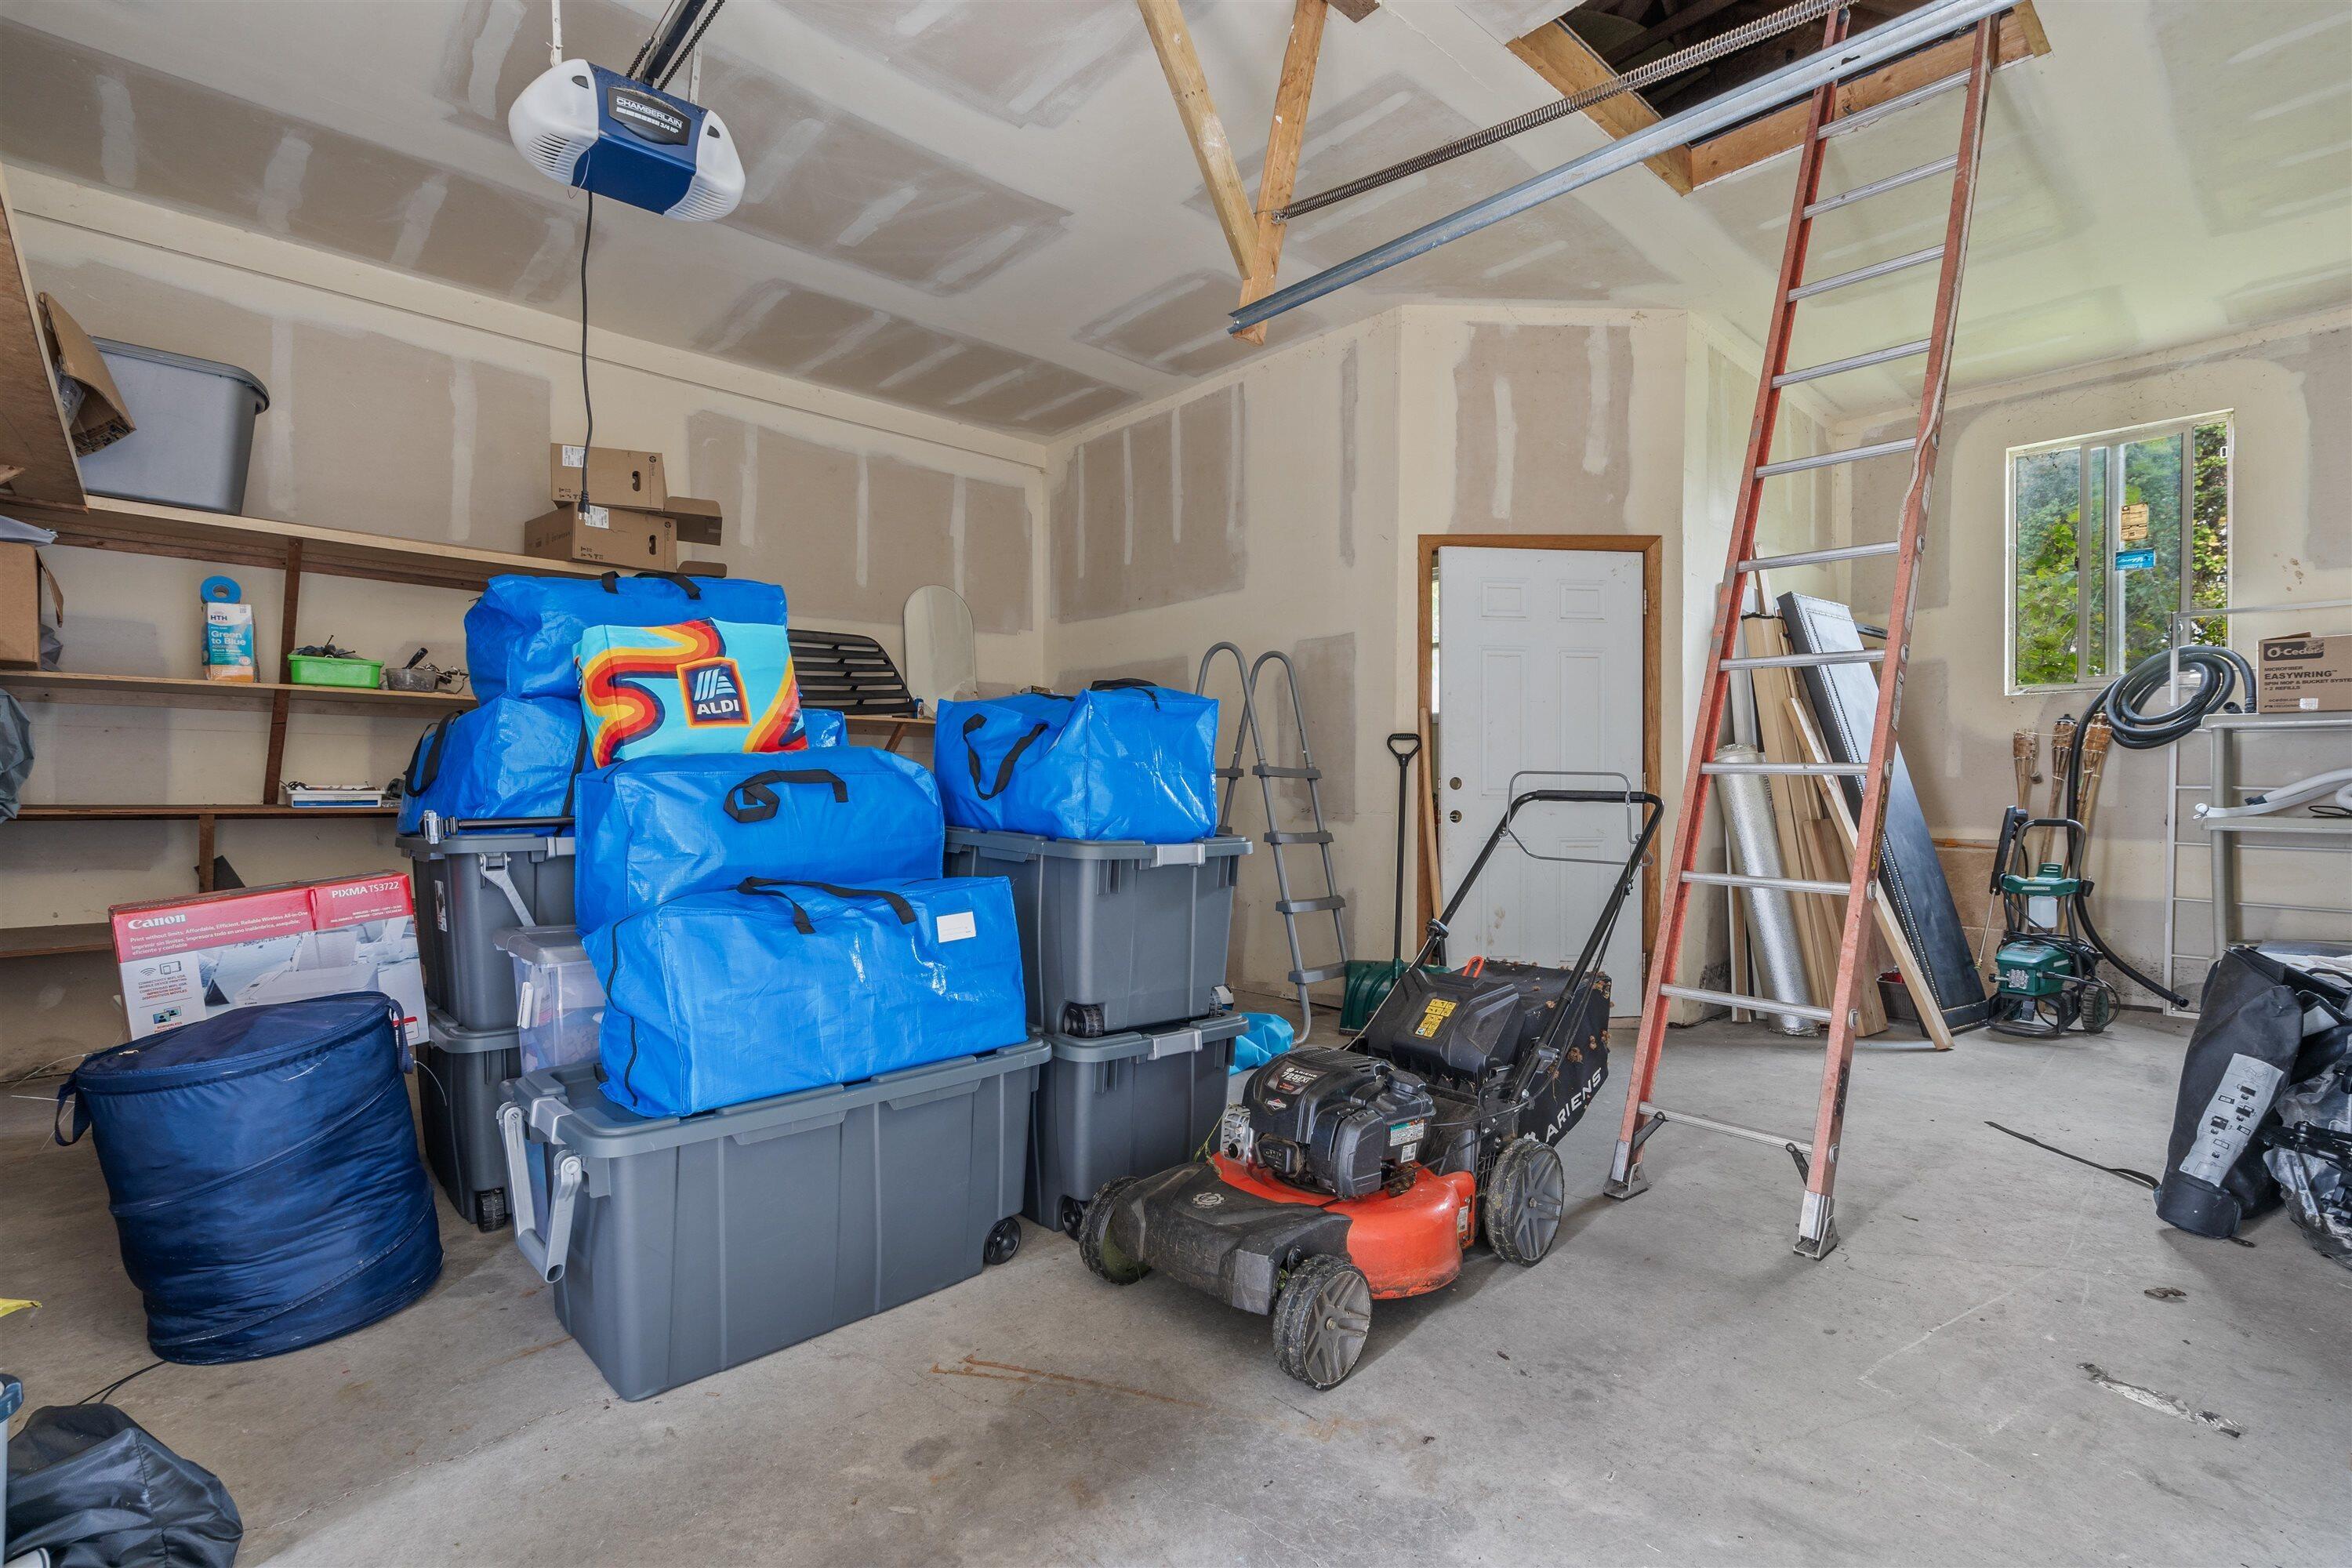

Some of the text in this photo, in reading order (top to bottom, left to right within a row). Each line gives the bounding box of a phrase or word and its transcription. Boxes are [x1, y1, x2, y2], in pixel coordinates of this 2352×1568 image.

[616, 98, 683, 128] CHAMBERLAIN
[211, 630, 242, 639] Green
[224, 637, 246, 646] Blue
[697, 699, 740, 714] ALDI
[332, 881, 399, 898] PIXMA TS3722
[128, 914, 186, 929] Canon
[132, 942, 154, 951] Imprimir
[186, 932, 212, 942] Impresora
[132, 947, 157, 956] eficiente
[162, 942, 187, 950] confiable
[1546, 1067, 1602, 1143] ARIENS
